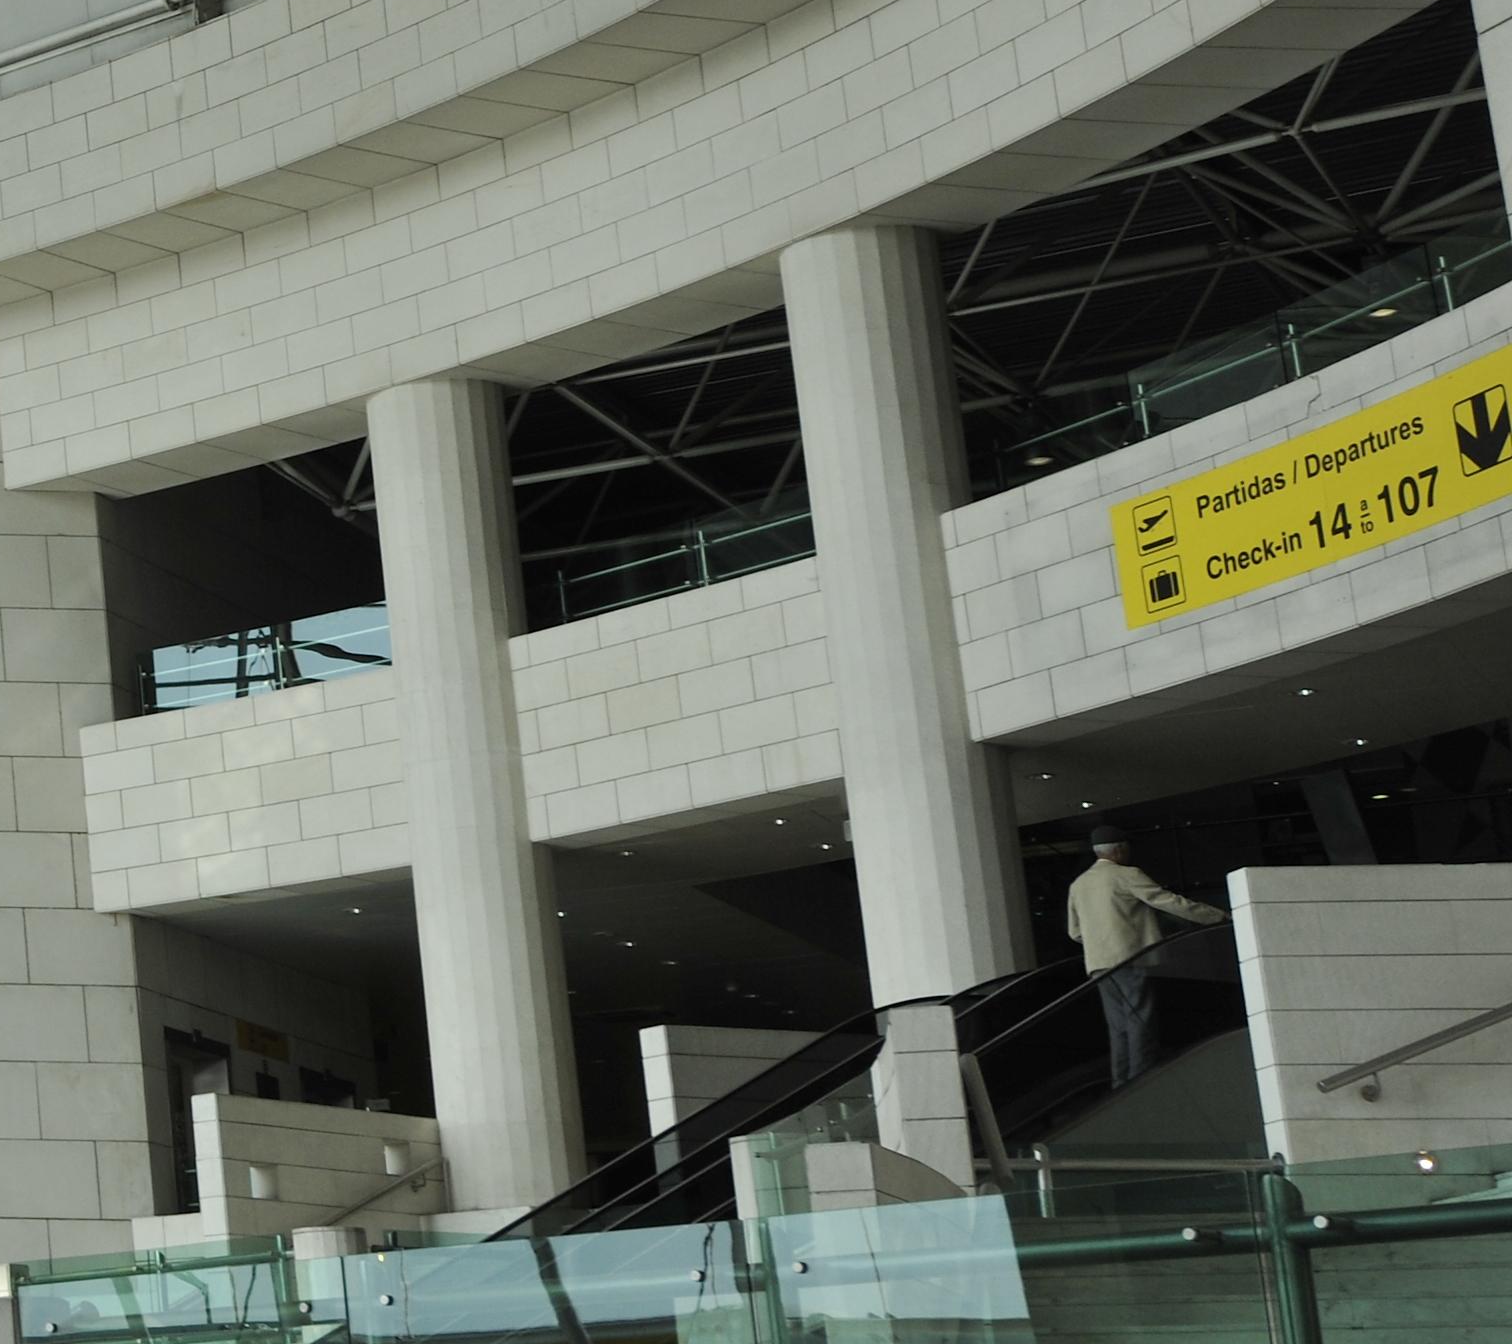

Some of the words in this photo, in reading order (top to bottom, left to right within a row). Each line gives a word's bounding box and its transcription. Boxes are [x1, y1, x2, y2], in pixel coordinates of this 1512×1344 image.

[1195, 471, 1287, 518] Partidas
[1304, 416, 1424, 478] Departures
[1206, 531, 1303, 580] Check-in
[1308, 502, 1352, 549] 14
[1376, 465, 1439, 523] 107
[1361, 519, 1374, 535] to
